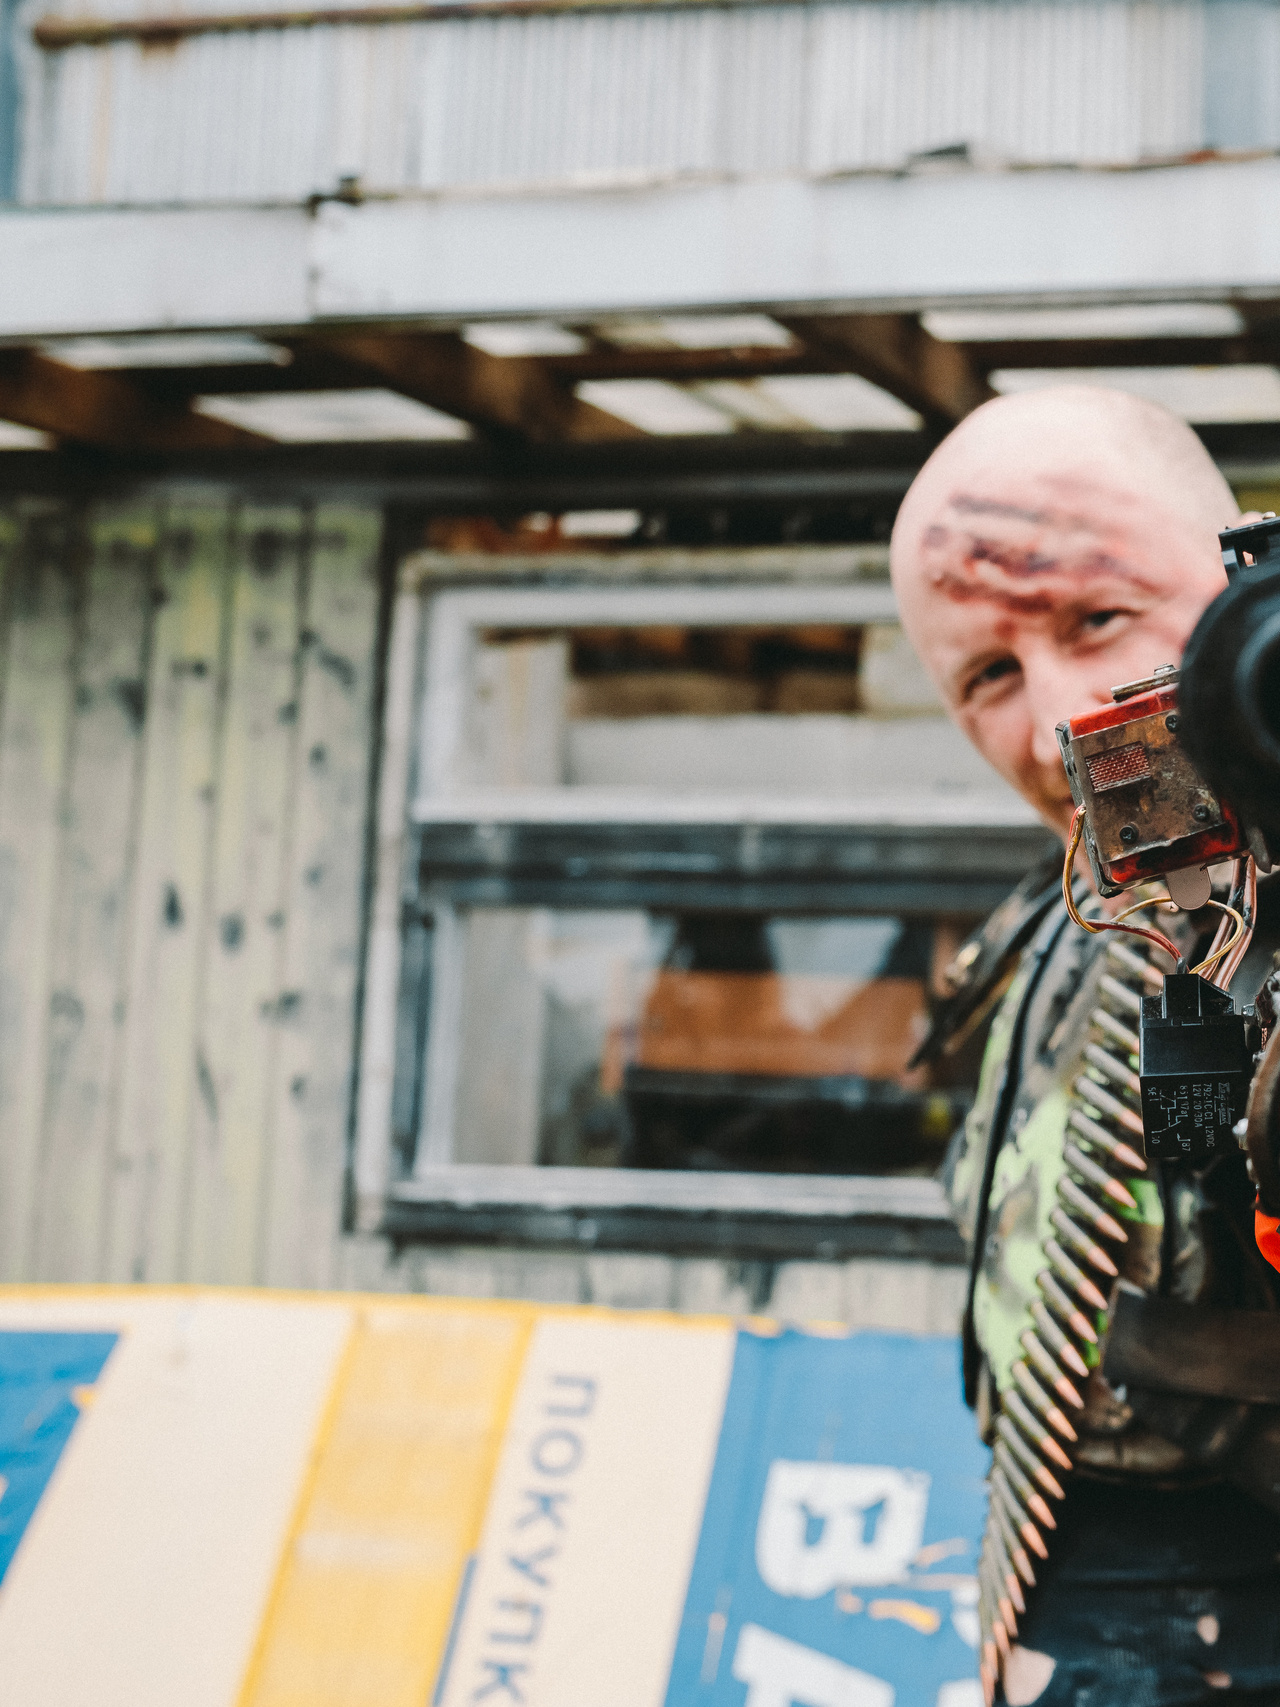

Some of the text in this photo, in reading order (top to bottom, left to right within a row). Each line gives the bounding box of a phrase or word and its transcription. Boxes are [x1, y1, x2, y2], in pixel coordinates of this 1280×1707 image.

[1193, 1084, 1201, 1097] 12V
[1205, 1126, 1215, 1147] 12VDC
[1181, 1142, 1190, 1151] 87
